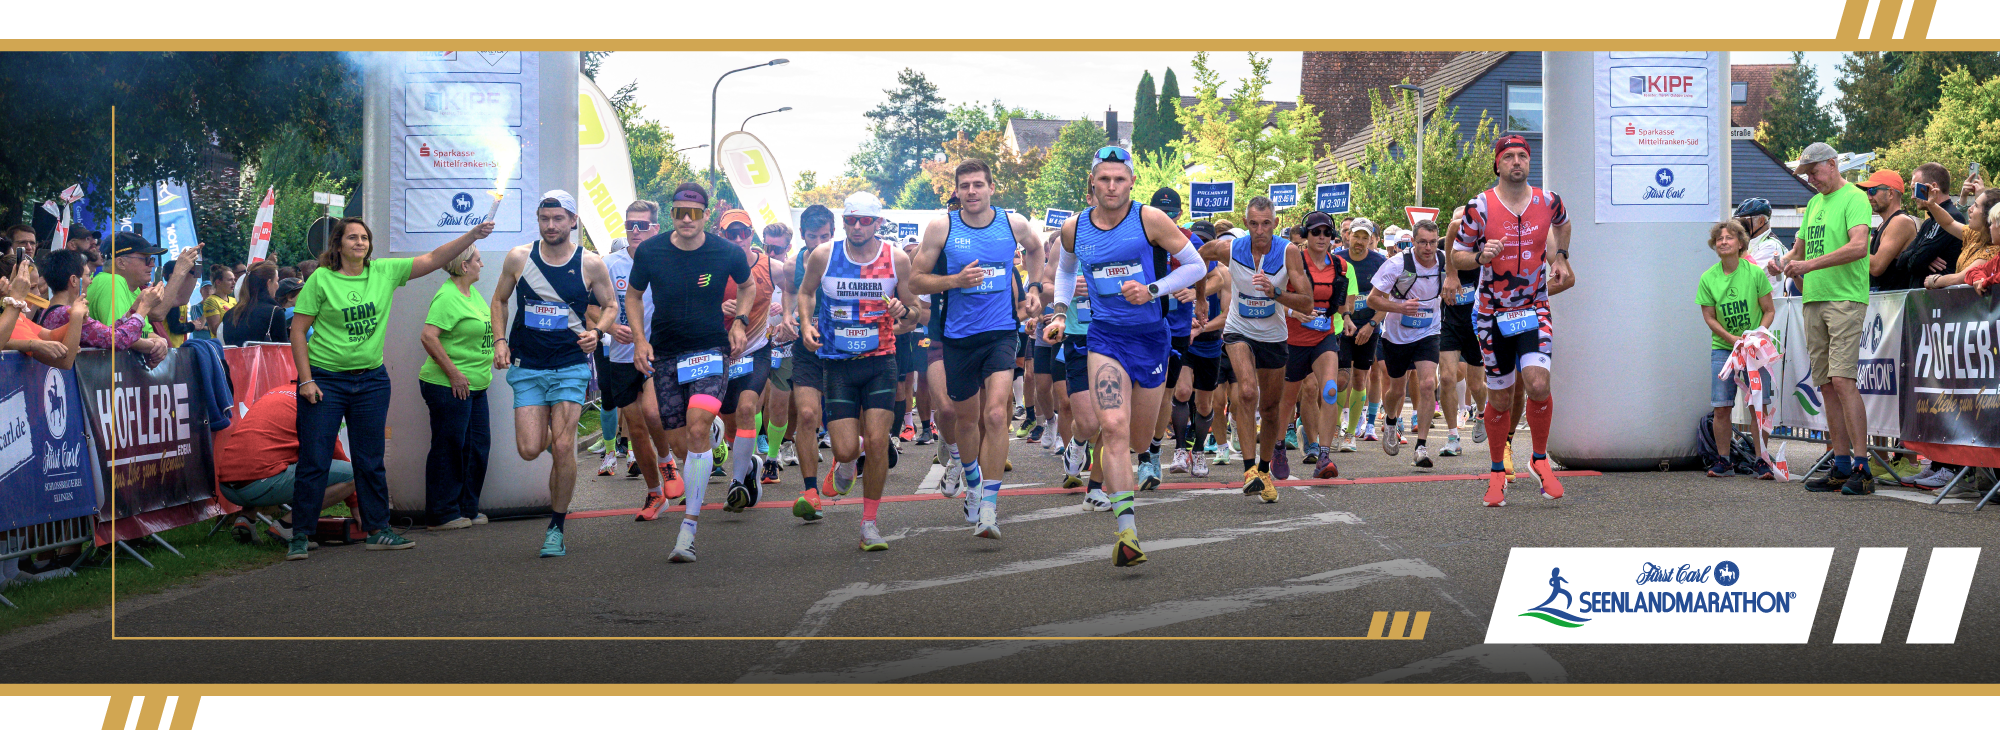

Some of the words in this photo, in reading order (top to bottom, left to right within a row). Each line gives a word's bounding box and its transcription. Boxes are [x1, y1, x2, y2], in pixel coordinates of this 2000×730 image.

[1647, 75, 1693, 93] KIPF
[1638, 128, 1675, 136] Sparkasse
[1638, 138, 1699, 146] Mittelfranken-Süd
[433, 149, 476, 158] Sparkasse
[1665, 186, 1686, 199] Carl
[1204, 197, 1222, 208] 3:30
[1223, 196, 1230, 207] H
[1808, 224, 1826, 240] TEAM
[954, 237, 971, 246] GEH
[1807, 239, 1825, 255] 2025
[836, 281, 846, 290] LA
[848, 282, 883, 291] CARRERA
[341, 301, 376, 323] TEAM
[1248, 308, 1266, 316] 236
[1719, 298, 1749, 317] TEAM
[345, 316, 378, 336] 2025
[538, 317, 552, 327] 44
[1313, 319, 1325, 328] 82
[1509, 319, 1528, 332] 370
[1724, 313, 1752, 329] 2025
[847, 340, 867, 350] 355
[1914, 308, 1994, 380] HÖFLER
[690, 365, 710, 378] 252
[1929, 390, 1957, 415] Liebe
[96, 371, 174, 451] HÖFLER
